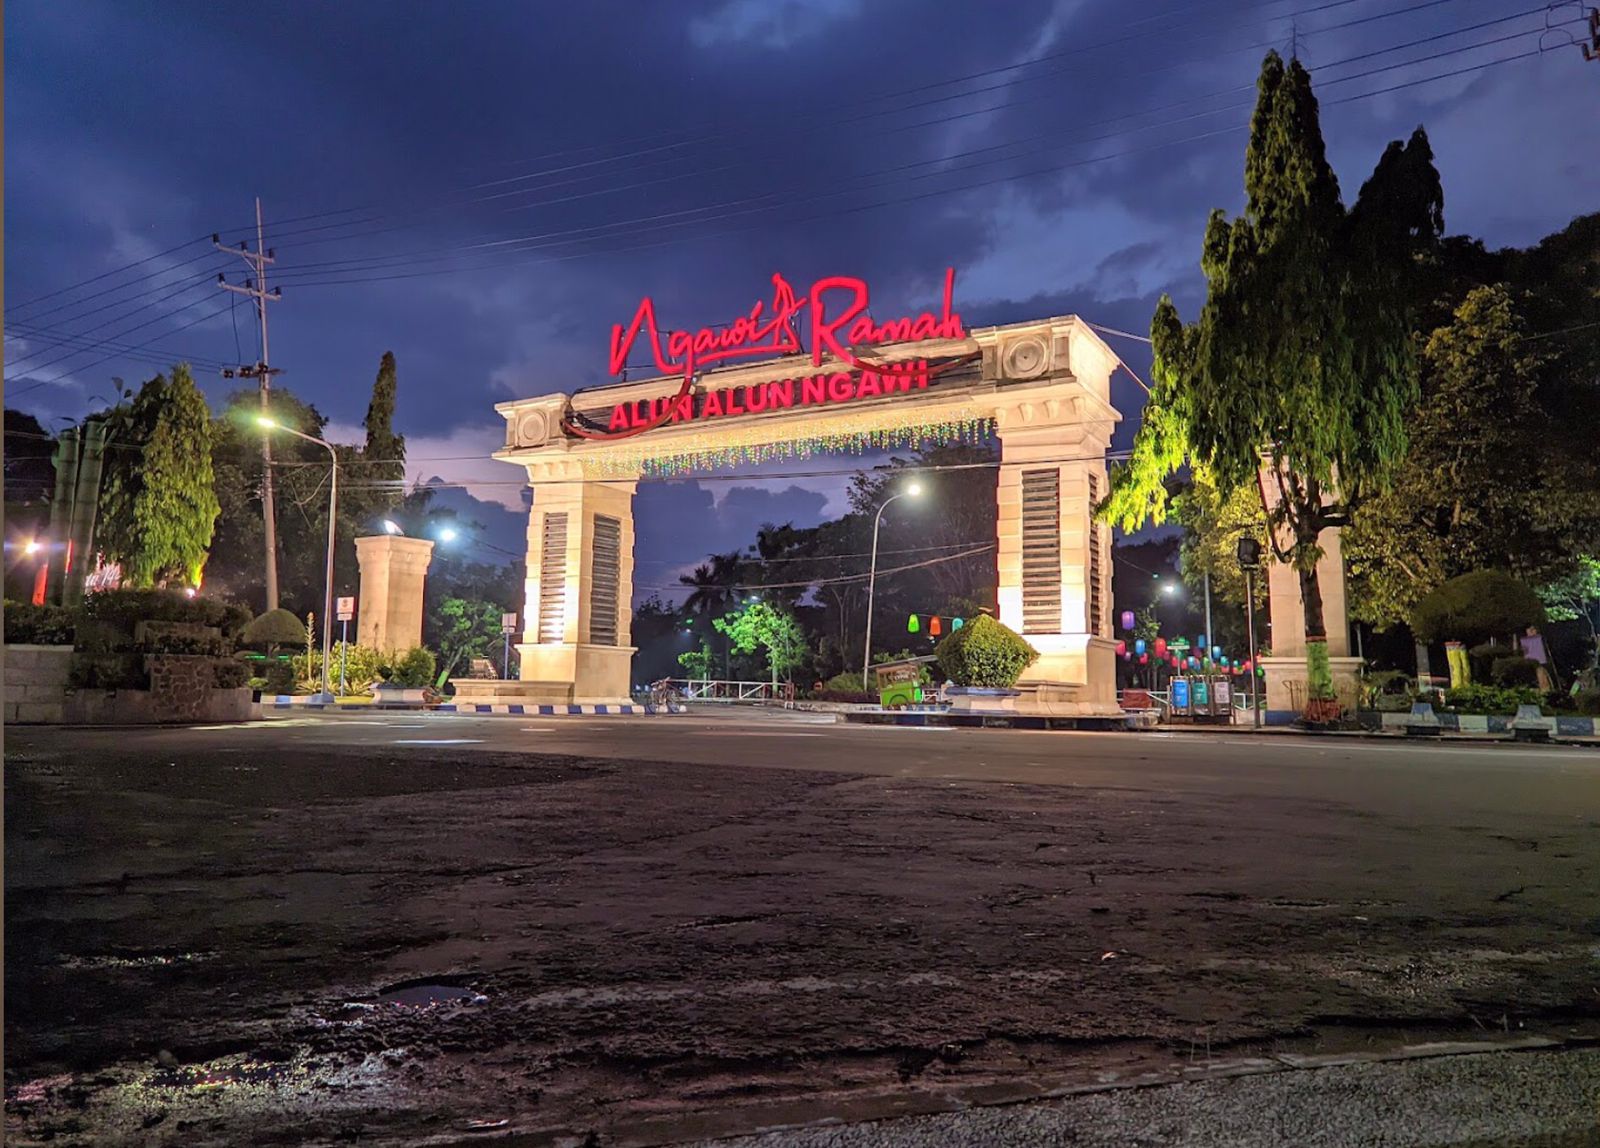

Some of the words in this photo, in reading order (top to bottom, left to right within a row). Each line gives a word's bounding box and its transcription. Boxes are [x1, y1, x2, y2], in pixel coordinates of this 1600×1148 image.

[608, 296, 799, 380] Ngawi
[810, 267, 966, 369] Ramah
[608, 394, 694, 431] ALUN
[702, 380, 794, 418] ALUN
[802, 359, 928, 406] NGAWI
